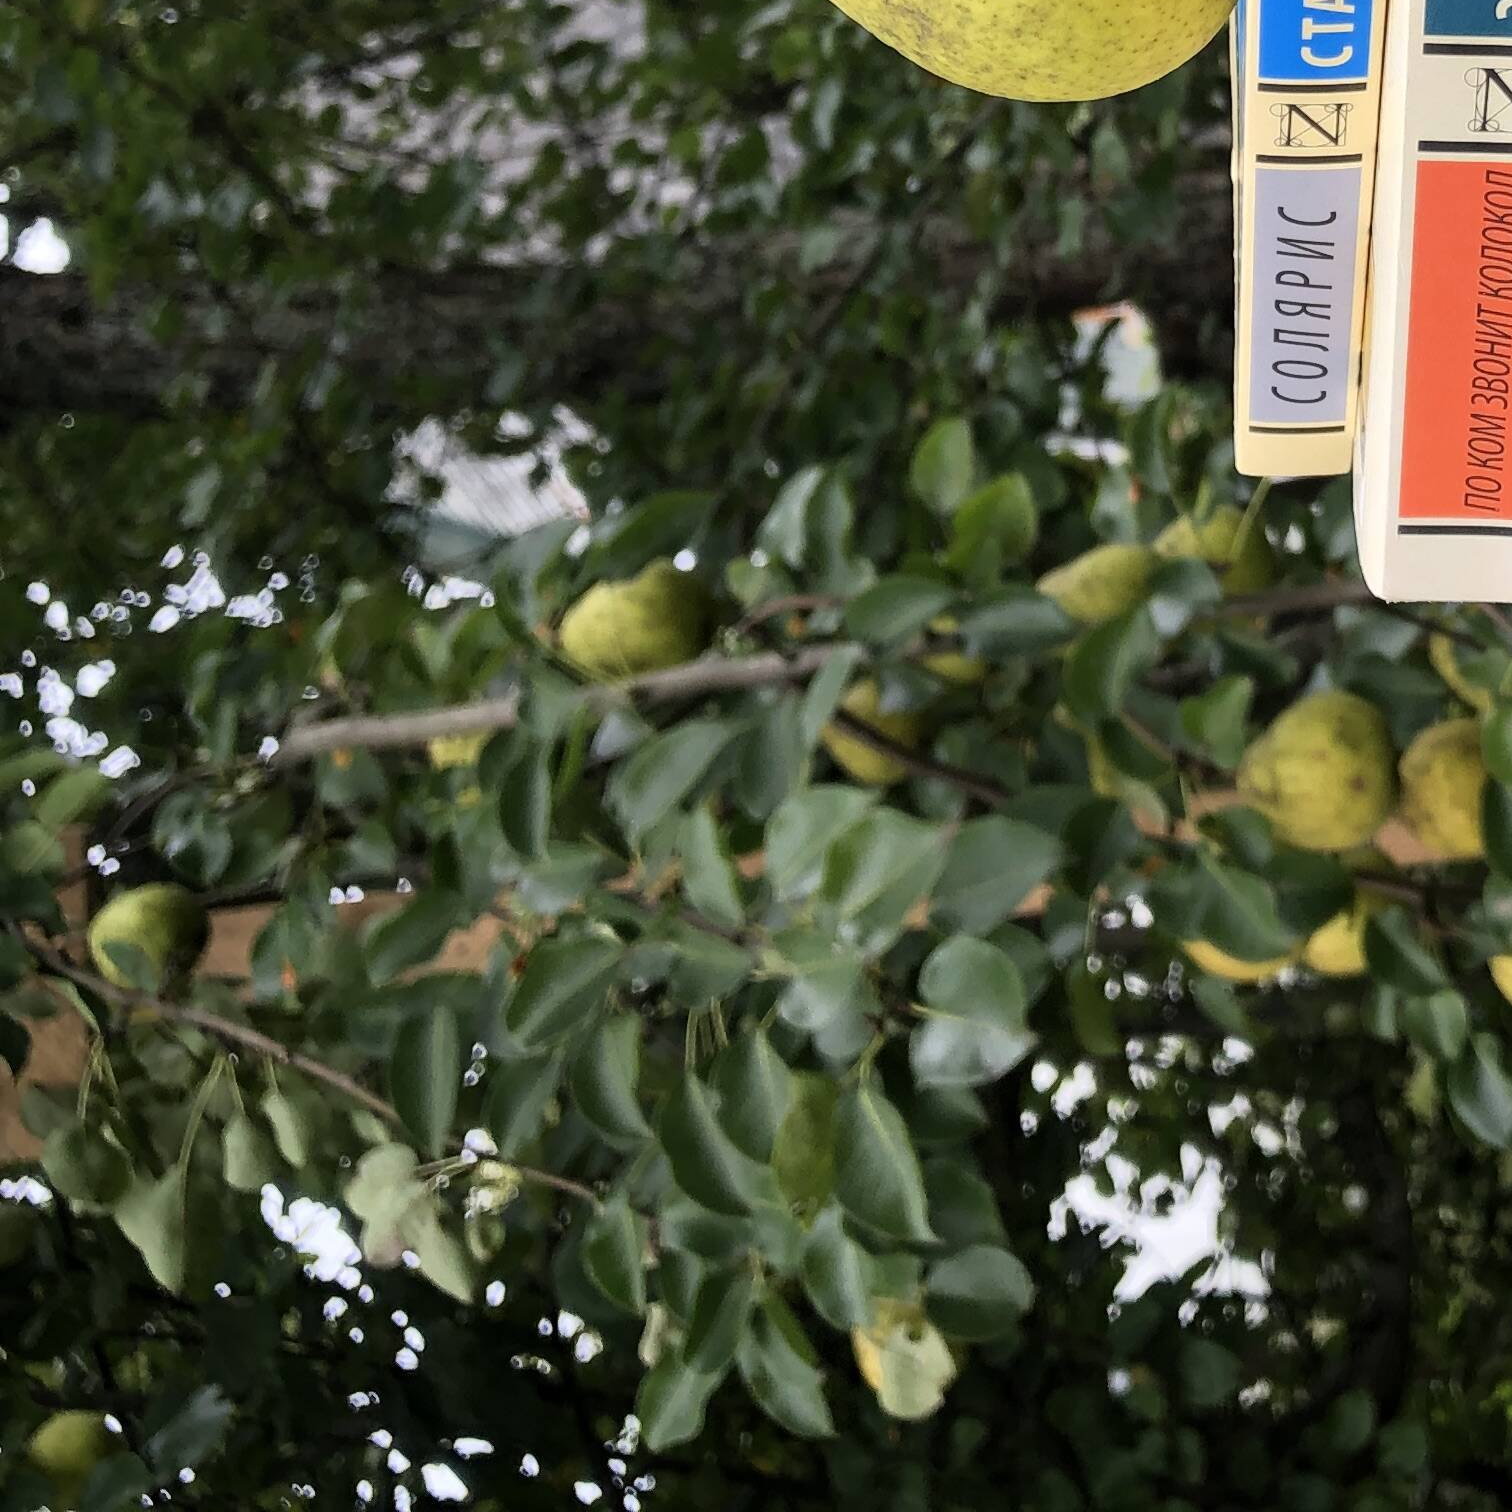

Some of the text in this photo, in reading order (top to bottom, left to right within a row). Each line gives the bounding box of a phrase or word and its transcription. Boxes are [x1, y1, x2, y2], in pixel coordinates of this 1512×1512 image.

[1270, 205, 1338, 406] СОЛЯРИС
[1466, 413, 1507, 472] КОМ
[1463, 472, 1502, 513] ПО
